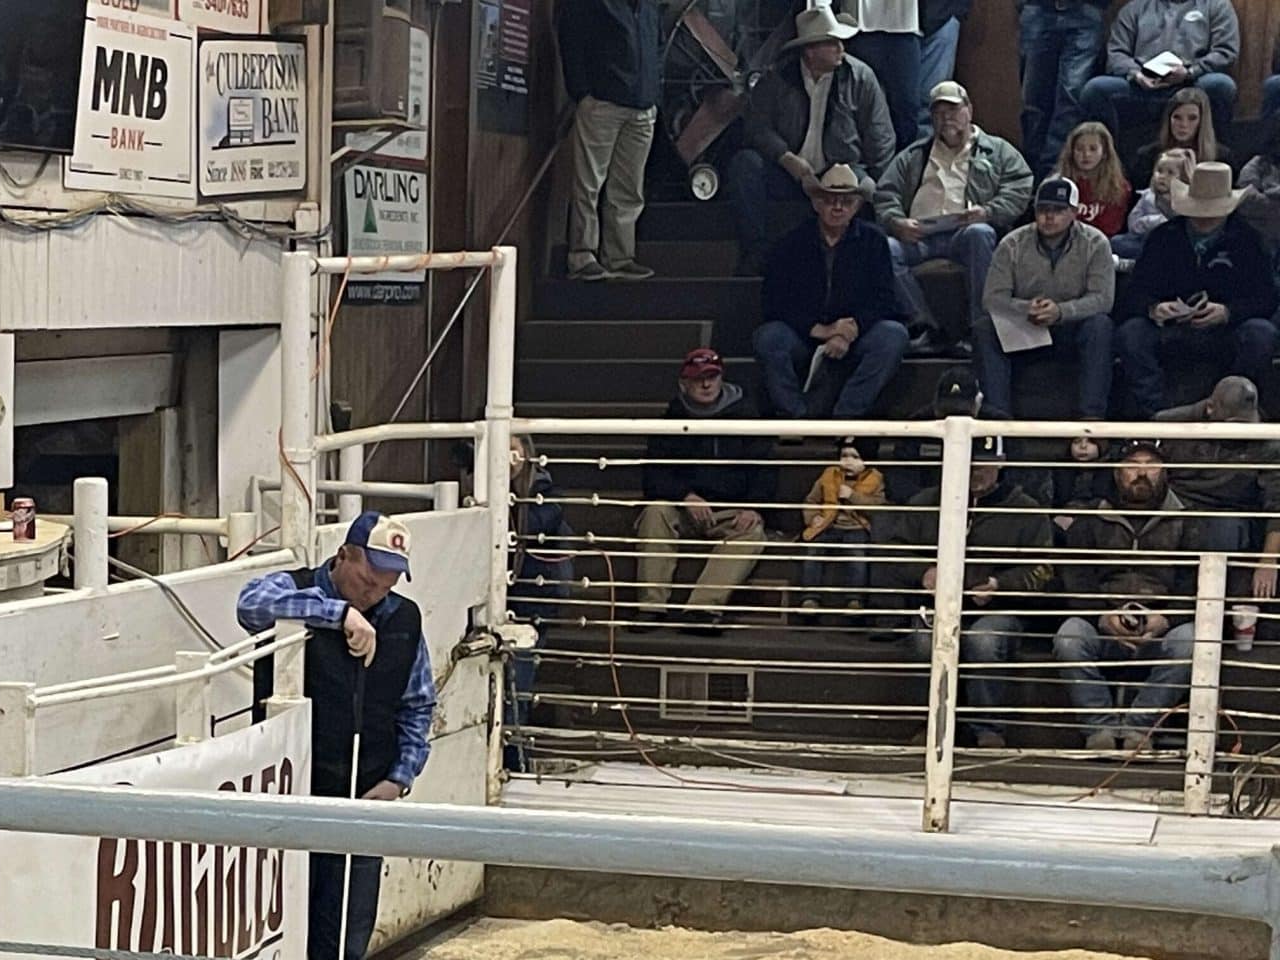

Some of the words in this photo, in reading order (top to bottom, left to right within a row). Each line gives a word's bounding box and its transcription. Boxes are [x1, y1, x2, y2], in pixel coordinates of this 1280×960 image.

[91, 45, 168, 120] MNB
[216, 52, 300, 97] CULBERTSON
[110, 127, 145, 151] BANK
[262, 97, 300, 139] BANK
[354, 168, 420, 203] DARLING
